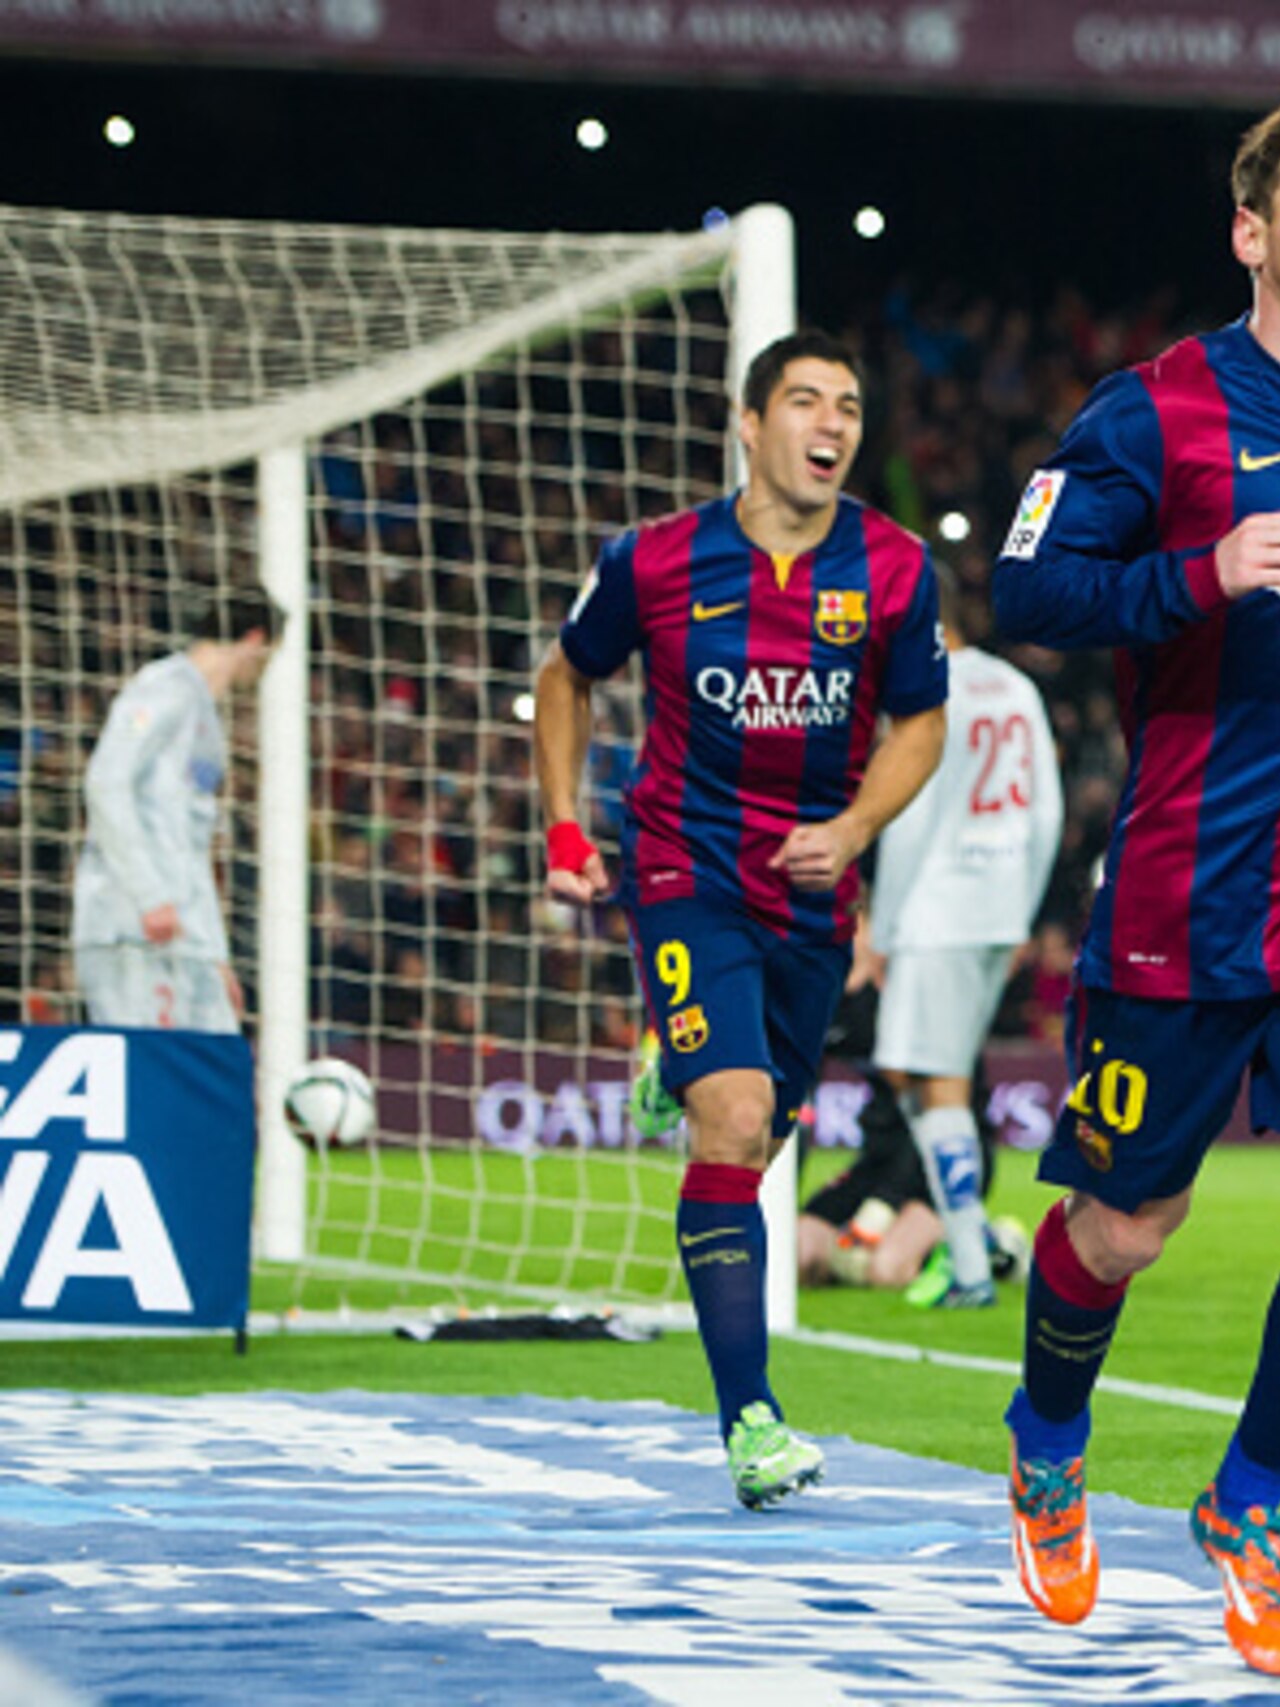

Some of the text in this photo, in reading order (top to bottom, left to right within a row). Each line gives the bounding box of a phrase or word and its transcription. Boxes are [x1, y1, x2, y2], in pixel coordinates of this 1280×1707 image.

[697, 667, 854, 712] QATAR
[968, 714, 1034, 816] 23
[655, 939, 691, 1006] 9
[477, 1079, 687, 1157] QAT
